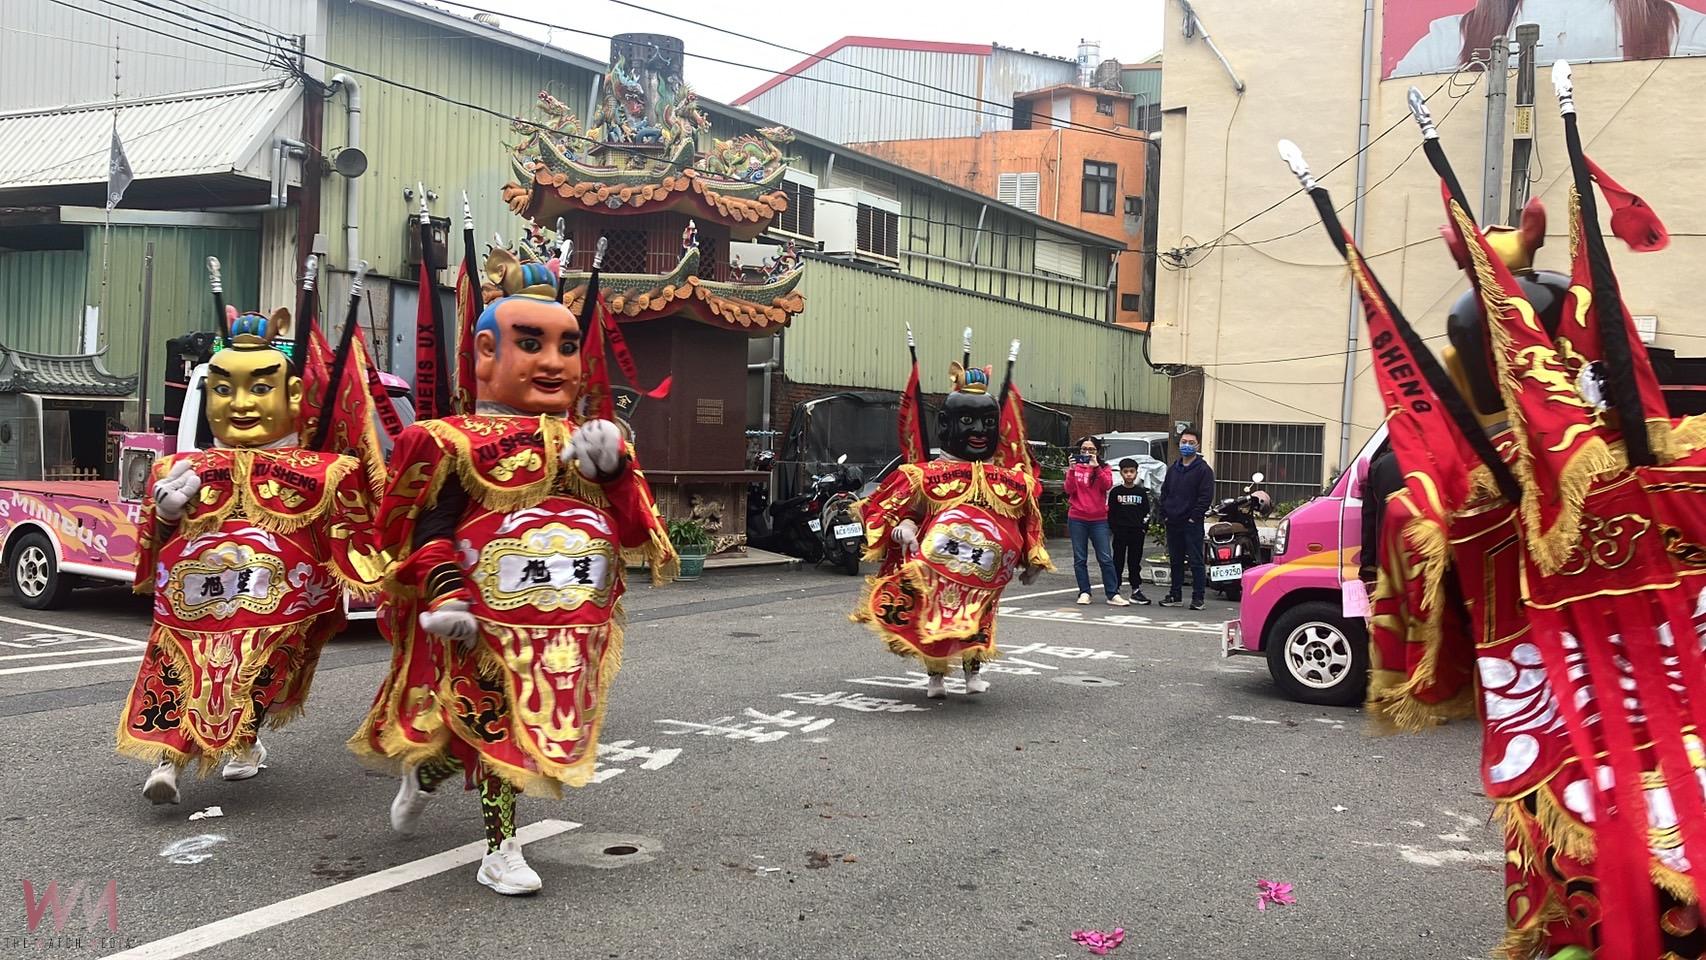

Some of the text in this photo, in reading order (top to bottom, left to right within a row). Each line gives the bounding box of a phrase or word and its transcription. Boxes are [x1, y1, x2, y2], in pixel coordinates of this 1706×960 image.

[616, 394, 632, 409] 金
[271, 465, 317, 491] SHENG
[11, 491, 109, 555] MINIBUS
